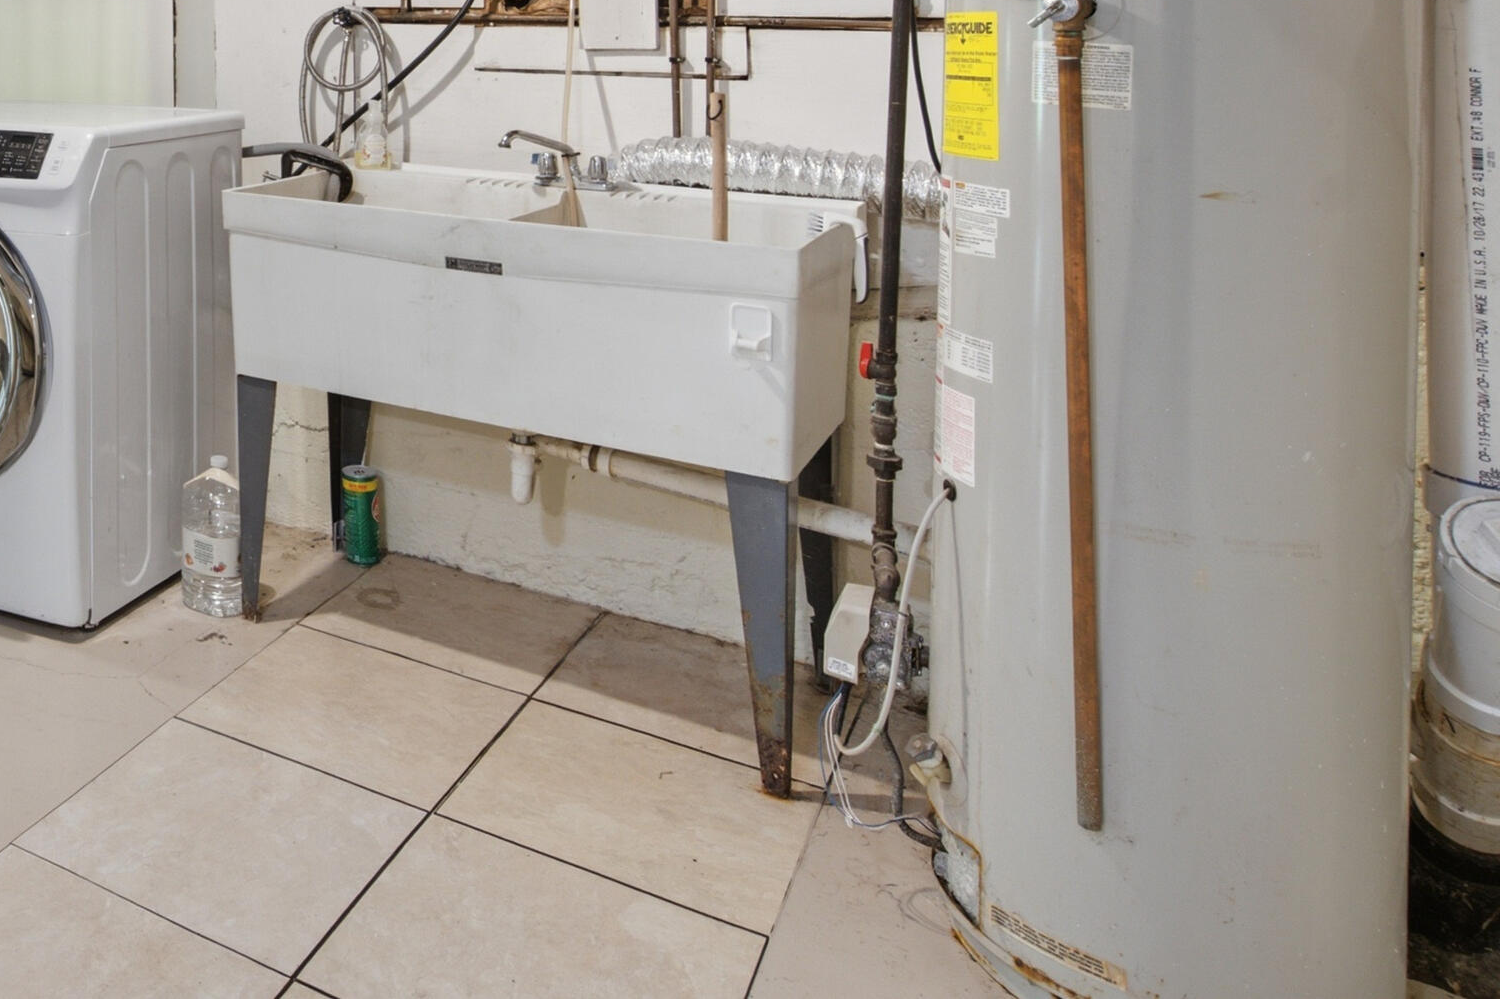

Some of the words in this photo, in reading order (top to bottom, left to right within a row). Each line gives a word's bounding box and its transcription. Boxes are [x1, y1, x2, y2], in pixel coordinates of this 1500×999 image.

[1474, 246, 1487, 277] U.S.A.
[1474, 278, 1487, 291] IN
[1475, 295, 1488, 316] MADE
